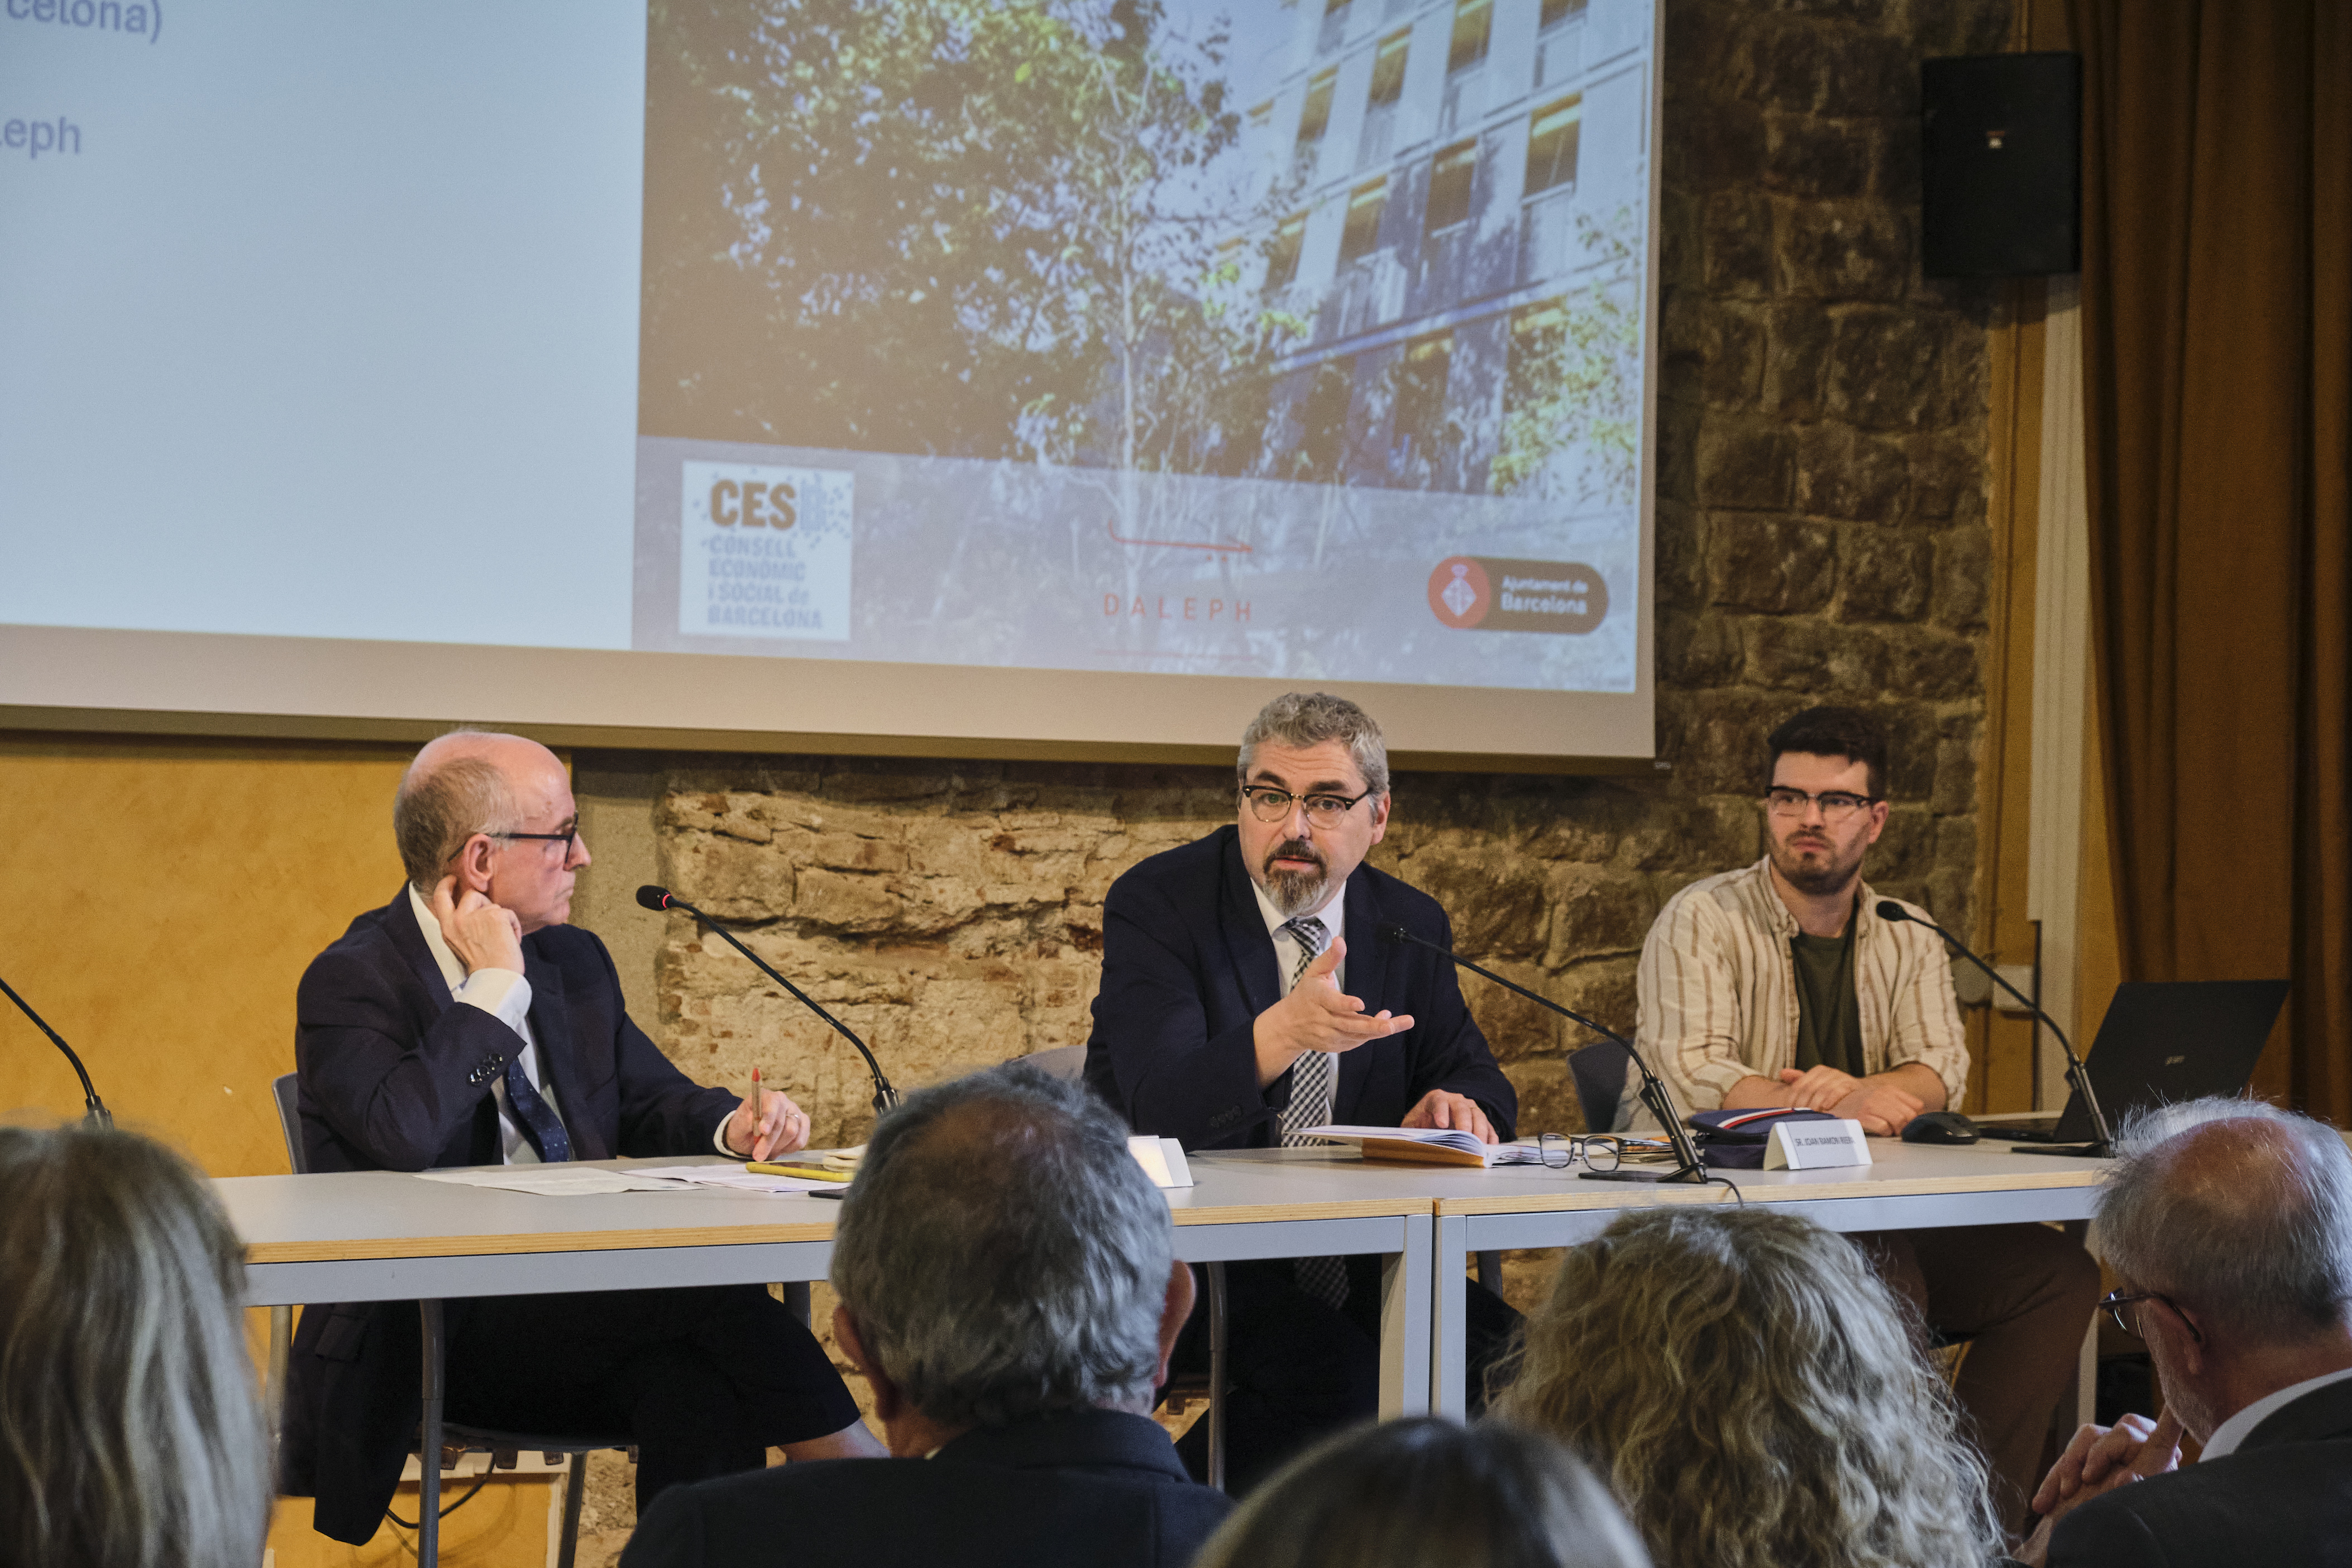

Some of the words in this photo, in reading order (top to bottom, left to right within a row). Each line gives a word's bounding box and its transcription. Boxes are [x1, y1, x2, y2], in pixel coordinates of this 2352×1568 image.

[7, 0, 162, 45] celona)
[0, 116, 81, 160] eph
[710, 479, 797, 530] CES
[709, 534, 796, 558] CONSELL
[718, 581, 784, 604] SOCIAL
[1500, 592, 1588, 615] Barcelona
[707, 604, 823, 629] BARCELONA
[1103, 592, 1251, 622] DALEPH
